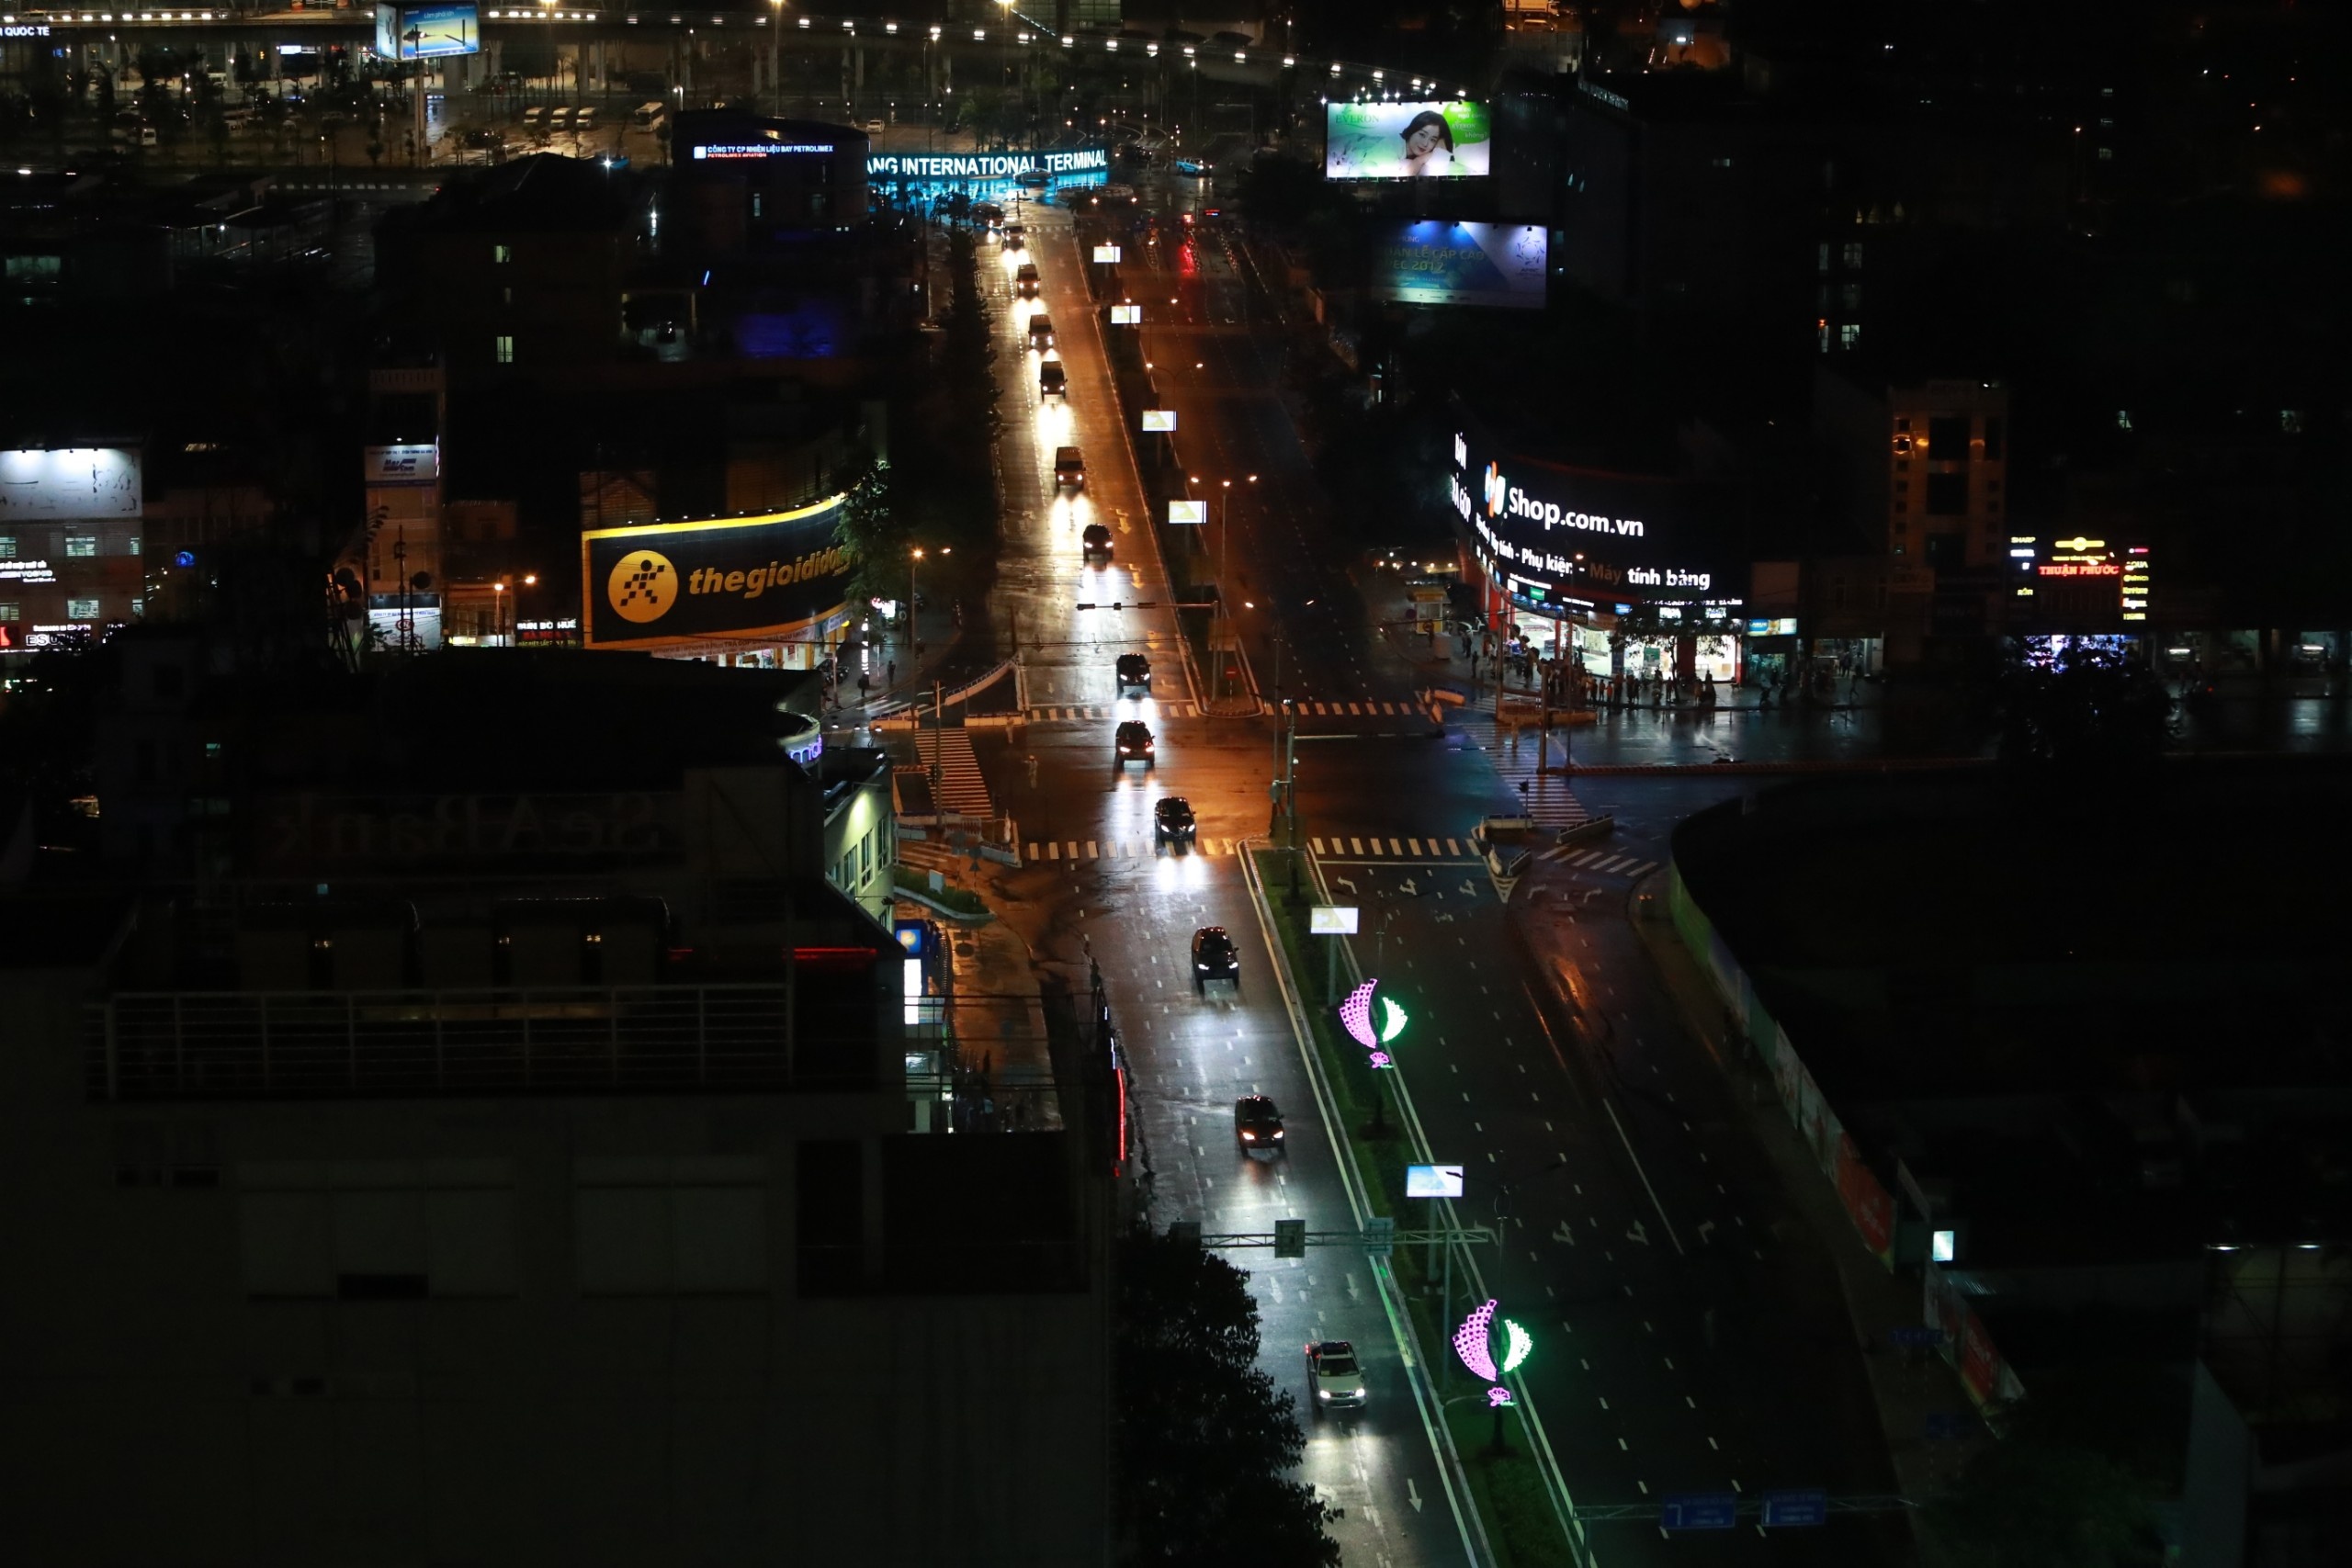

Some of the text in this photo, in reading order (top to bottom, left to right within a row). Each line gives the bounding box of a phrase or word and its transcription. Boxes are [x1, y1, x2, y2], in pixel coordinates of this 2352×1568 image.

[5, 25, 50, 37] QUỐC TẾ
[1335, 114, 1380, 124] EVERON
[707, 145, 727, 153] CÔNG
[746, 144, 765, 153] NHIÊN
[765, 144, 780, 154] LIỆU
[901, 155, 1035, 176] INTERNATIONAL
[1045, 150, 1108, 172] TERMINAL
[1509, 487, 1644, 537] Shop.com.vn
[1521, 548, 1544, 572] Phụ
[1589, 562, 1623, 585] Máy
[1627, 567, 1661, 586] tính
[1666, 569, 1711, 591] bảng
[2039, 563, 2077, 577] THUẬN
[2079, 562, 2120, 576] PHƯỚC
[557, 619, 577, 629] HUẾ
